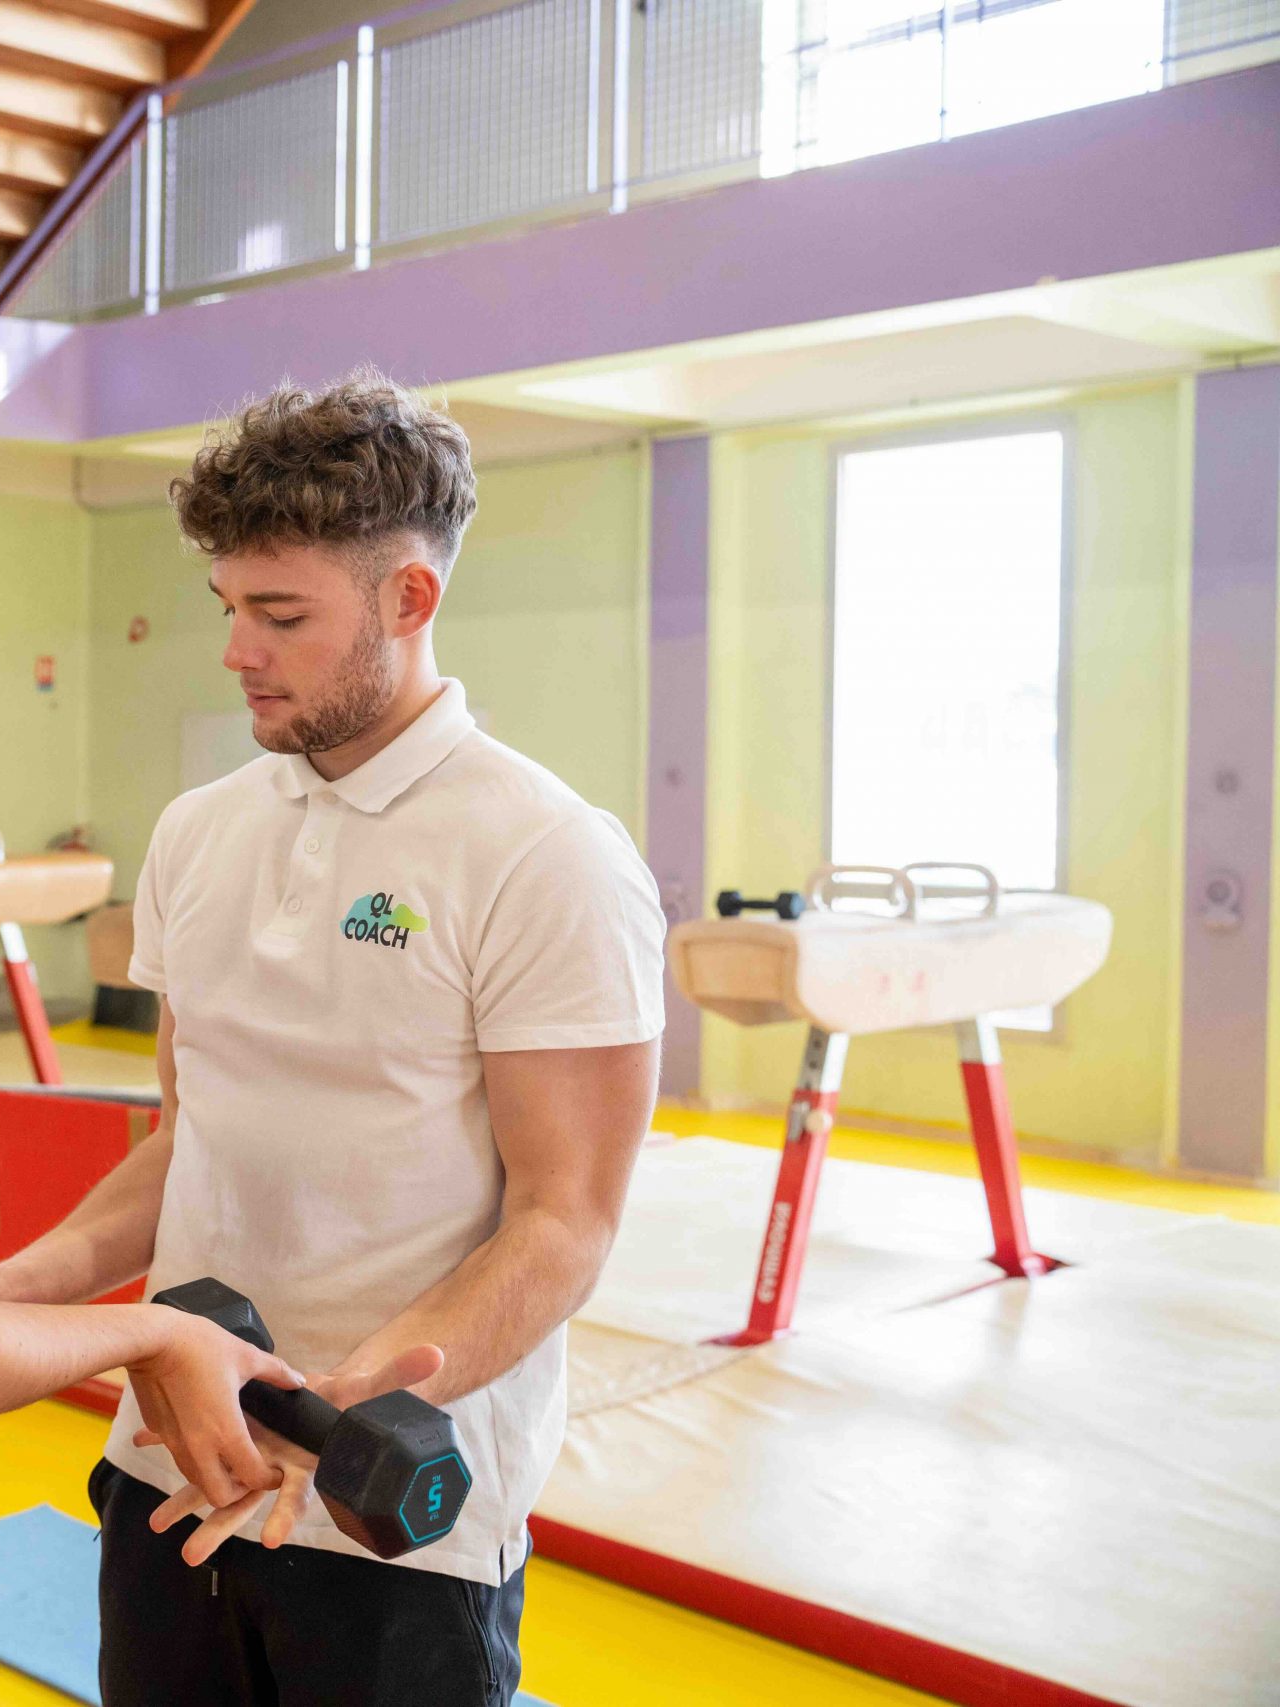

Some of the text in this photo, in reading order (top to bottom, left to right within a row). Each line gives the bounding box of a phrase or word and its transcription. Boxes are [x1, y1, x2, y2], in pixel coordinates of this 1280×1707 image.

[370, 891, 394, 918] QL
[344, 917, 410, 950] COACH
[428, 1482, 443, 1513] 5
